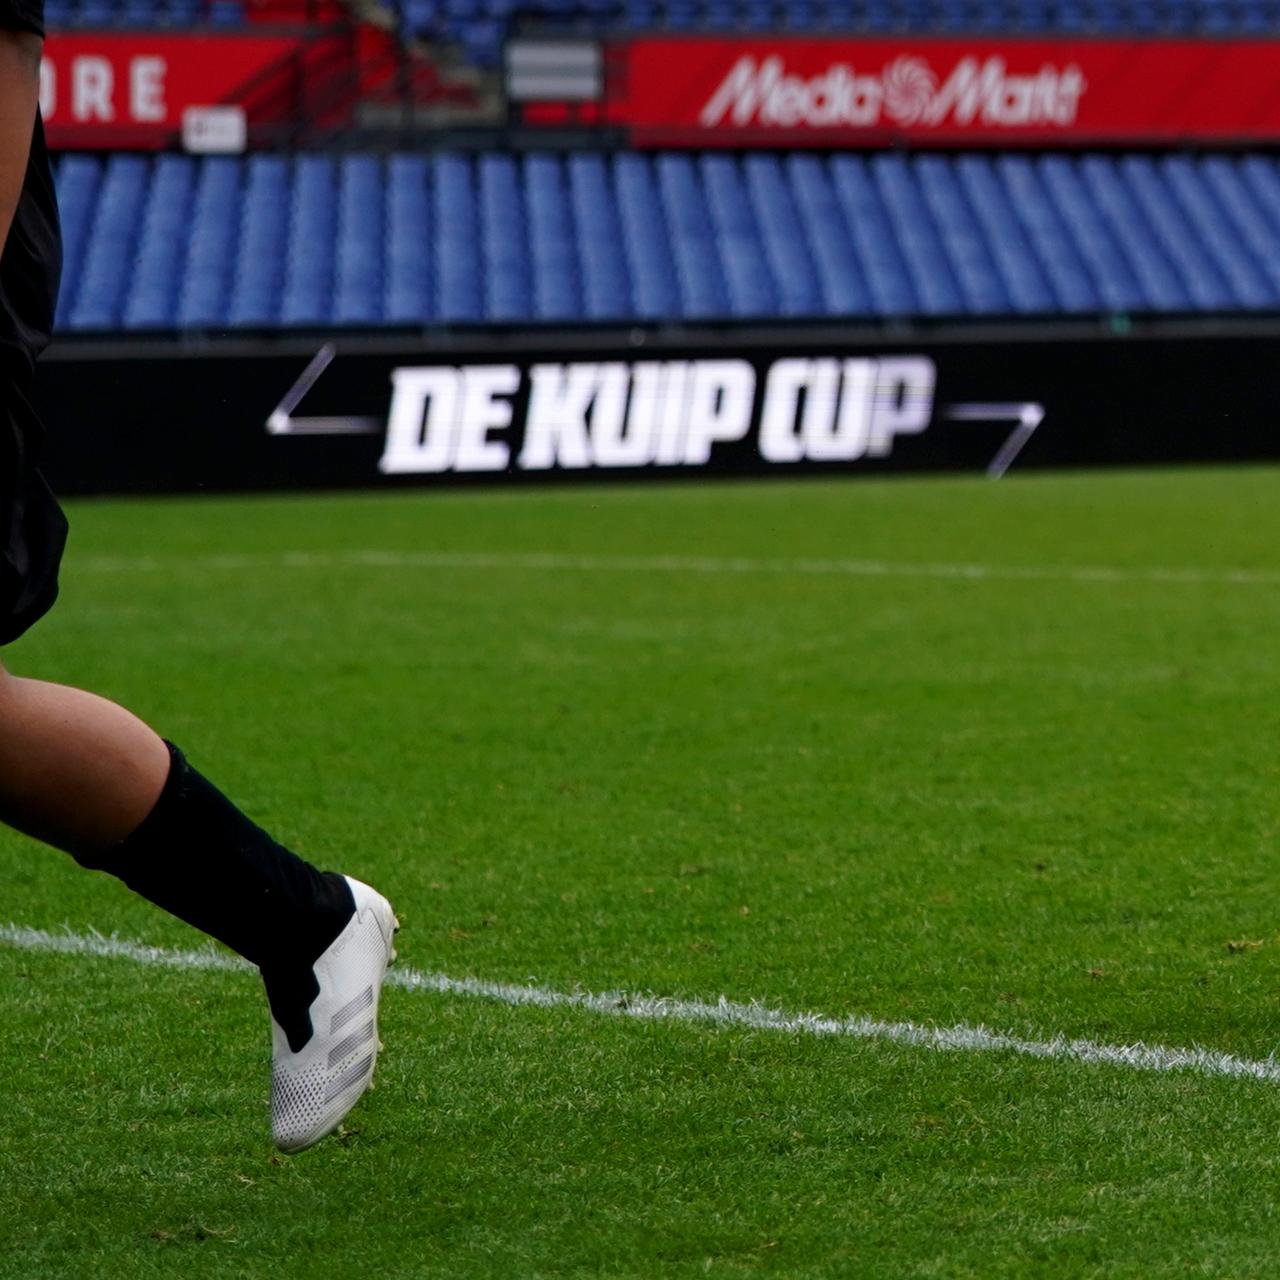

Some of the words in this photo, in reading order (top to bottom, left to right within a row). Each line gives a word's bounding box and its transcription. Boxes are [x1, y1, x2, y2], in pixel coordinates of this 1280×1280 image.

[379, 365, 520, 474] DE
[519, 360, 757, 471] KUIP
[757, 355, 937, 463] CUP
